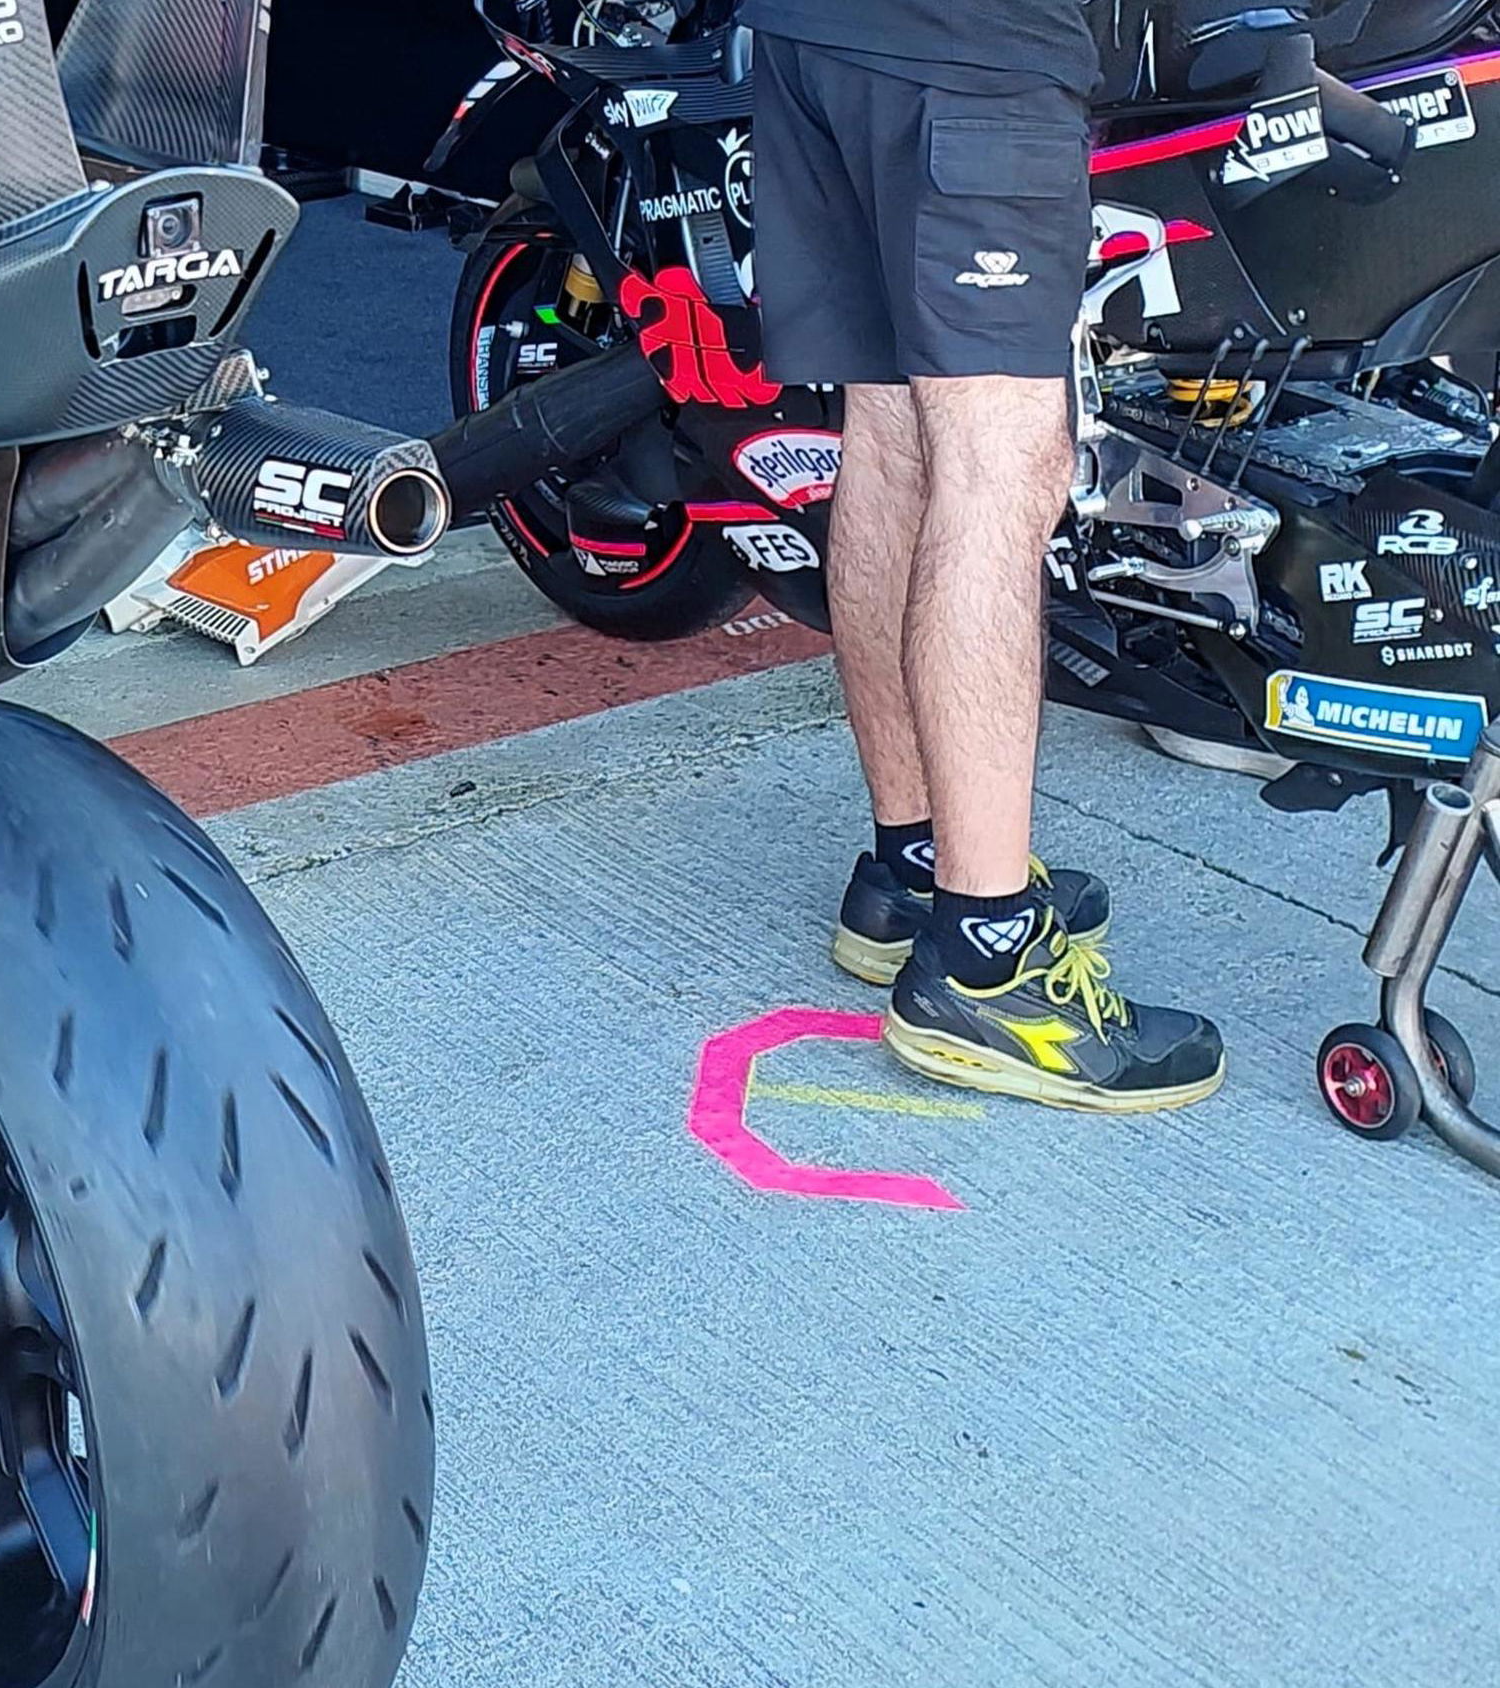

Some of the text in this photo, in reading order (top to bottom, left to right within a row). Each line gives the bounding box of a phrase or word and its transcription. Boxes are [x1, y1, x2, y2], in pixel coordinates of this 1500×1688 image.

[603, 98, 630, 129] sky
[639, 186, 722, 222] PRAGMATIC
[99, 249, 242, 300] TARGA
[518, 343, 558, 362] SC
[254, 460, 352, 514] SC
[253, 500, 343, 527] PROJECT
[1377, 535, 1459, 555] RCB
[1320, 560, 1371, 594] RK
[1355, 598, 1425, 630] SC
[1396, 642, 1473, 662] SHAREBOT
[1316, 700, 1463, 740] MICHELIN
